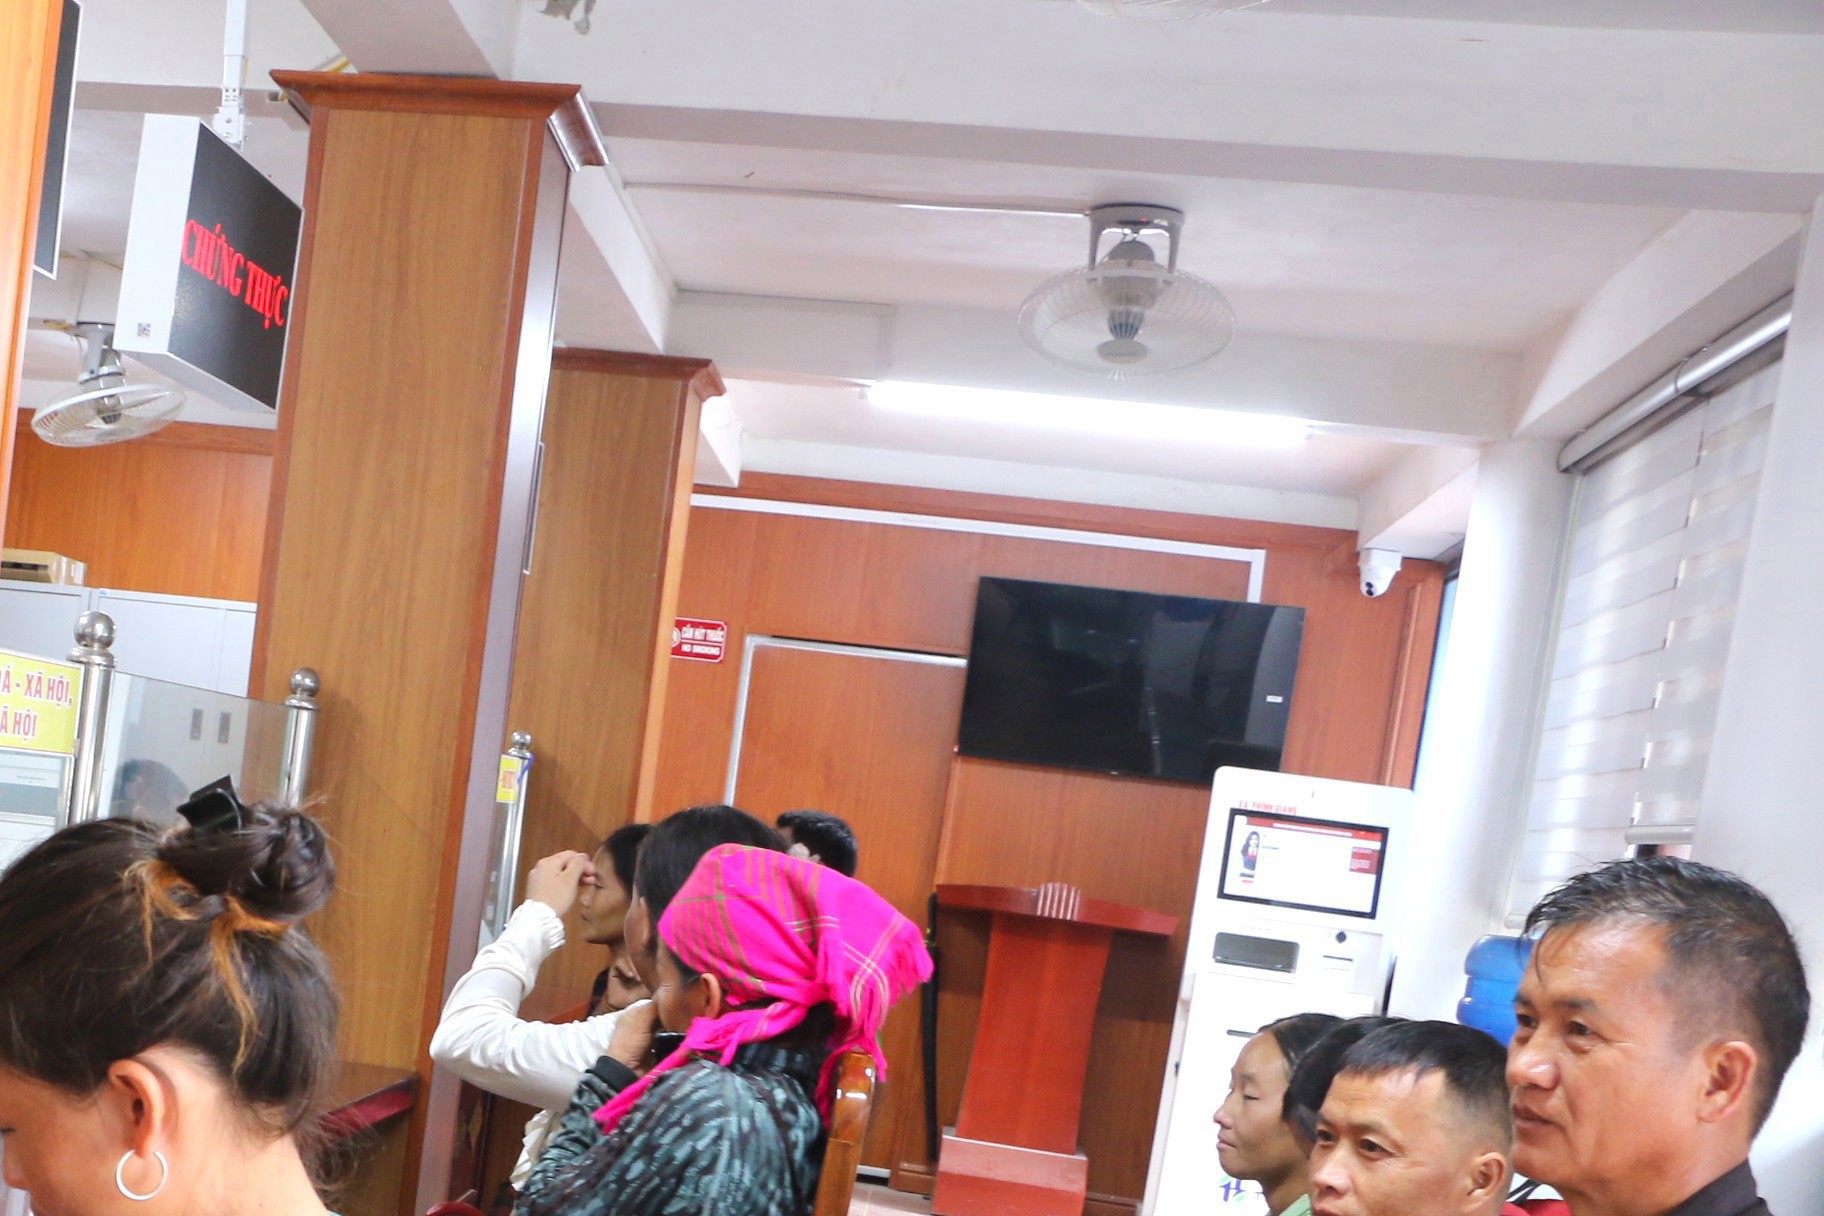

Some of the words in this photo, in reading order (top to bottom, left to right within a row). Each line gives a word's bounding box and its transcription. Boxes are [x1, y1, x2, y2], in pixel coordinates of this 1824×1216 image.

[181, 219, 245, 297] CHỨNG
[244, 260, 288, 329] THỰC
[24, 671, 43, 699] XÃ
[46, 674, 72, 707] HỘI,
[12, 708, 37, 741] HỘI
